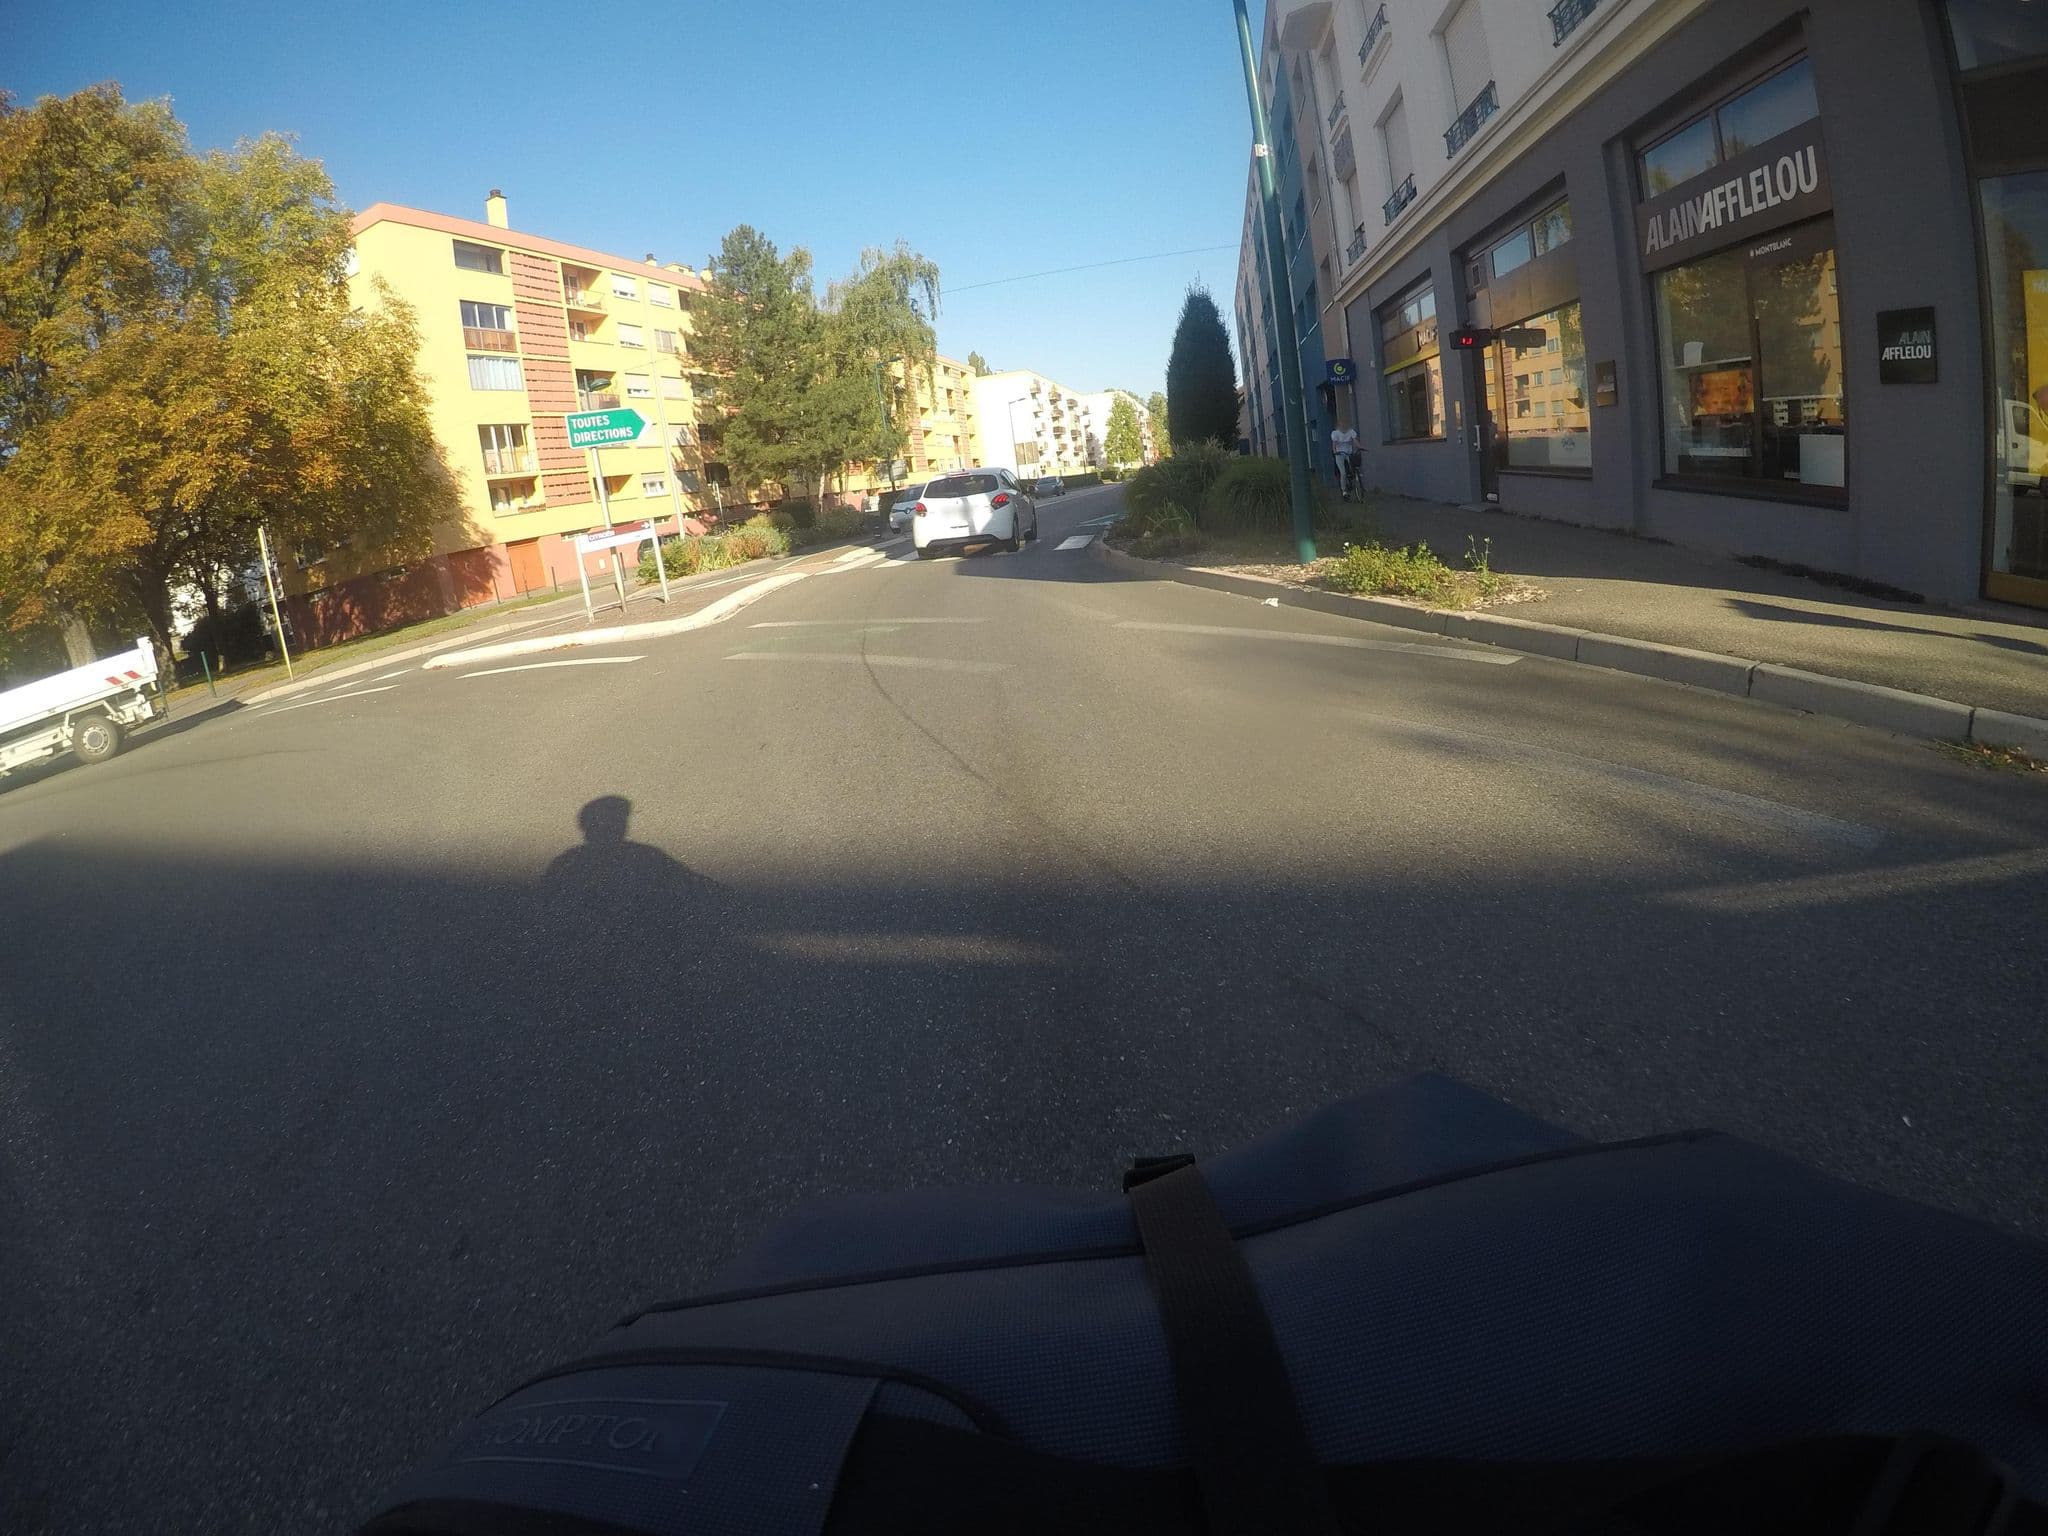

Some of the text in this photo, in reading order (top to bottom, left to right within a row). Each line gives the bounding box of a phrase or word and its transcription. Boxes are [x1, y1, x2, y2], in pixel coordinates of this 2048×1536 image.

[1645, 145, 1818, 256] ALAIN AFFLELOU
[1898, 329, 1931, 345] ALAIN
[1881, 344, 1932, 361] AFFLELOU
[571, 414, 610, 430] TOUTES
[573, 426, 634, 444] DIRECTIONS
